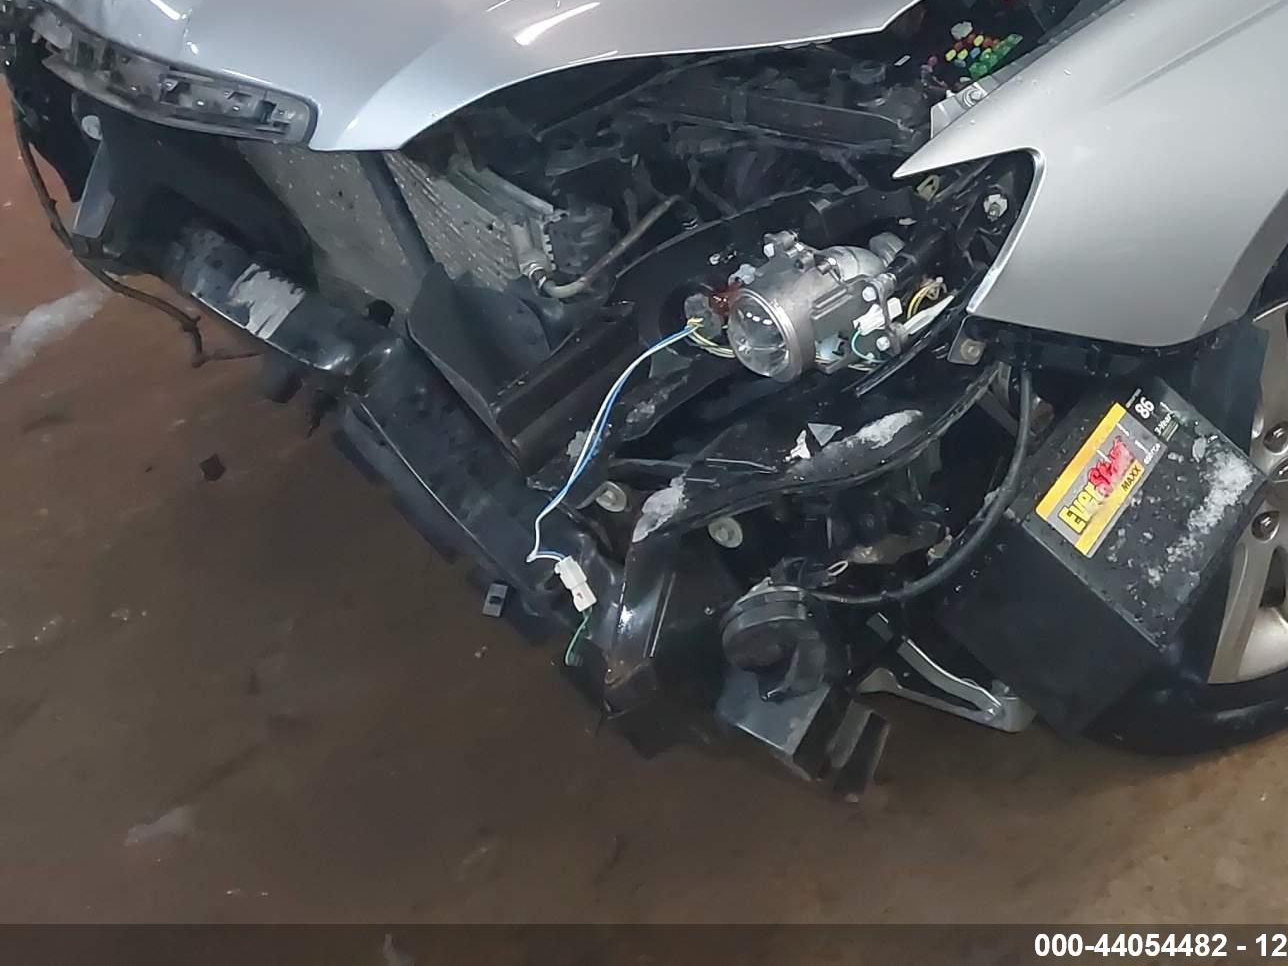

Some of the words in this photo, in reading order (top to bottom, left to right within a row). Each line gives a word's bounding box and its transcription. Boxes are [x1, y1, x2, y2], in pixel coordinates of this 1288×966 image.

[1135, 397, 1154, 419] 86
[1154, 413, 1173, 435] 3-Year
[1121, 465, 1142, 492] MAXX
